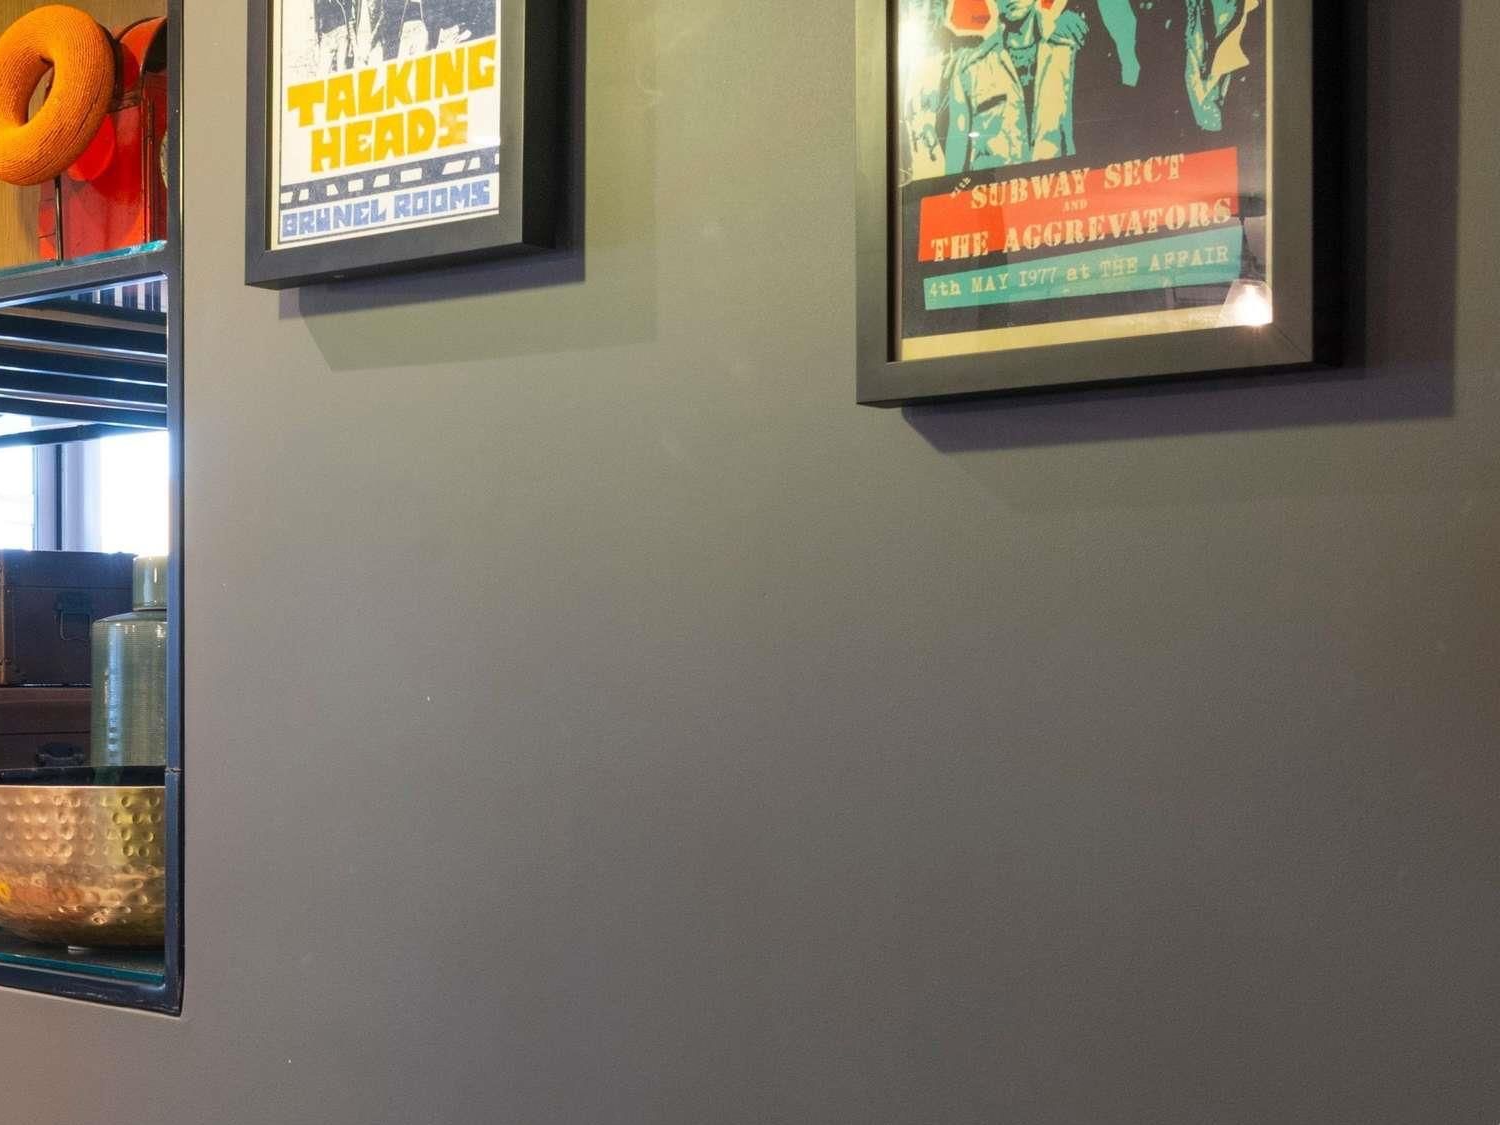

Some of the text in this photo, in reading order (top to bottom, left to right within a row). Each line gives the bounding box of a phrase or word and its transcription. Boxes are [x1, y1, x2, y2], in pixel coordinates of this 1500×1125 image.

[287, 39, 497, 128] TALKING
[311, 98, 468, 173] HEADS
[282, 179, 490, 238] BRUNEL ROOMS
[970, 167, 1091, 209] SUBWAY
[1104, 153, 1185, 190] SECT
[931, 198, 1232, 262] THE AGGREVATORS
[929, 279, 962, 298] 4th
[971, 272, 1010, 294] MAY
[1065, 263, 1091, 282] at
[1100, 256, 1138, 278] THE
